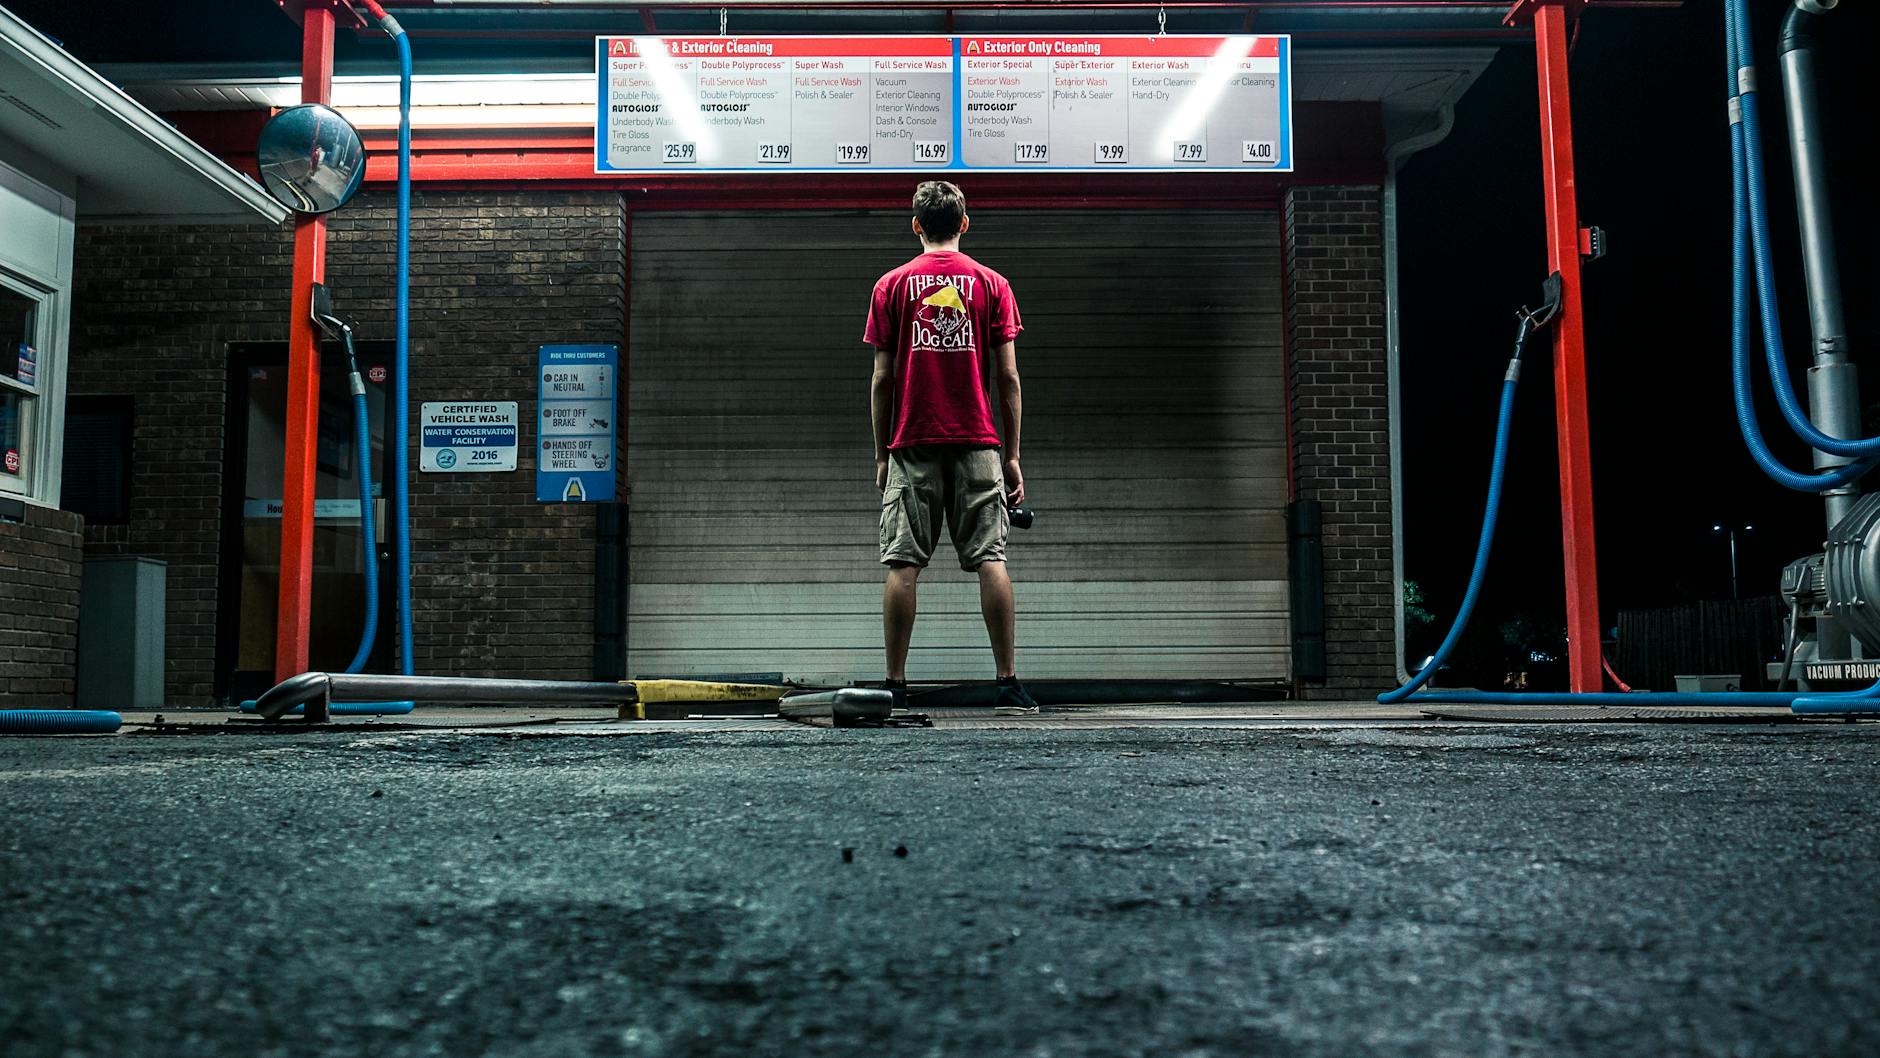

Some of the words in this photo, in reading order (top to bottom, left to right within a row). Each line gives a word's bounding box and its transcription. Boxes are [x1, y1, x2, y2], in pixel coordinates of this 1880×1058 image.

[672, 41, 681, 54] &
[682, 41, 725, 54] Exterior
[726, 40, 773, 55] Cleaning
[984, 41, 1026, 54] Exterior
[1028, 41, 1051, 55] Only
[1054, 40, 1101, 55] Cleaning
[612, 62, 637, 70] Super
[702, 61, 730, 69] Double
[795, 62, 819, 70] Super
[968, 60, 1000, 68] Exterior
[1003, 60, 1033, 69] Special
[1055, 62, 1079, 70] Super
[1082, 61, 1115, 69] Exterior
[612, 78, 627, 87] Full
[701, 78, 715, 86] Full
[716, 78, 745, 86] Service
[746, 78, 767, 86] Wash
[796, 78, 810, 86] Full
[812, 78, 839, 86] Service
[841, 78, 862, 86] Wash
[876, 78, 907, 86] Vacuum
[968, 77, 998, 85] Exterior
[1000, 77, 1020, 85] Wash
[1055, 78, 1085, 86] Exterior
[1086, 78, 1108, 86] Wash
[1132, 78, 1162, 87] Exterior
[1242, 78, 1275, 88] Cleaning
[612, 91, 640, 100] Double
[701, 91, 729, 99] Double
[796, 91, 819, 99] Polish
[820, 91, 827, 99] &
[829, 91, 854, 99] Sealer
[876, 91, 906, 99] Exterior
[907, 91, 941, 101] Cleaning
[968, 90, 995, 99] Double
[1056, 90, 1079, 99] Polish
[1080, 90, 1087, 99] &
[1089, 90, 1113, 99] Sealer
[1132, 91, 1170, 101] Hand-Dry
[876, 104, 904, 112] Interior
[905, 104, 940, 112] Windows
[612, 117, 654, 128] Underbody
[705, 117, 742, 127] nderbody
[744, 117, 765, 125] Wash
[876, 117, 896, 125] Dash
[898, 117, 904, 125] &
[906, 117, 937, 125] Console
[968, 116, 1010, 126] Underbody
[1011, 116, 1032, 124] Wash
[612, 130, 627, 139] Tire
[628, 130, 650, 139] Gloss
[876, 130, 914, 140] Hand-Dry
[968, 129, 983, 138] Tire
[984, 129, 1006, 138] Gloss
[612, 144, 651, 154] Fragrance
[664, 144, 694, 158] $25.99
[760, 145, 790, 159] $21.99
[838, 146, 868, 159] $19.99
[916, 144, 946, 158] $16.99
[1018, 145, 1047, 159] $17.99
[1100, 146, 1124, 159] $9.99
[1179, 144, 1202, 158] $7.99
[1248, 144, 1271, 157] $4.00
[908, 275, 935, 301] THE
[936, 274, 977, 301] SALTY
[912, 320, 940, 348] DOG
[554, 374, 569, 382] CAR
[570, 374, 578, 382] IN
[553, 383, 586, 392] NEUTRAL
[553, 409, 572, 418] FOOT
[573, 409, 588, 418] OFF
[479, 415, 509, 423] WASH
[552, 418, 576, 427] BRAKE
[455, 428, 515, 436] CONSERVATION
[452, 437, 487, 445] FACILITY
[552, 441, 577, 450] HANDS
[578, 441, 593, 450] OFF
[472, 451, 498, 460] 2016
[552, 450, 588, 459] STEERING
[552, 460, 577, 469] WHEEL
[267, 504, 283, 514] Hou
[1806, 665, 1842, 680] VACUUM
